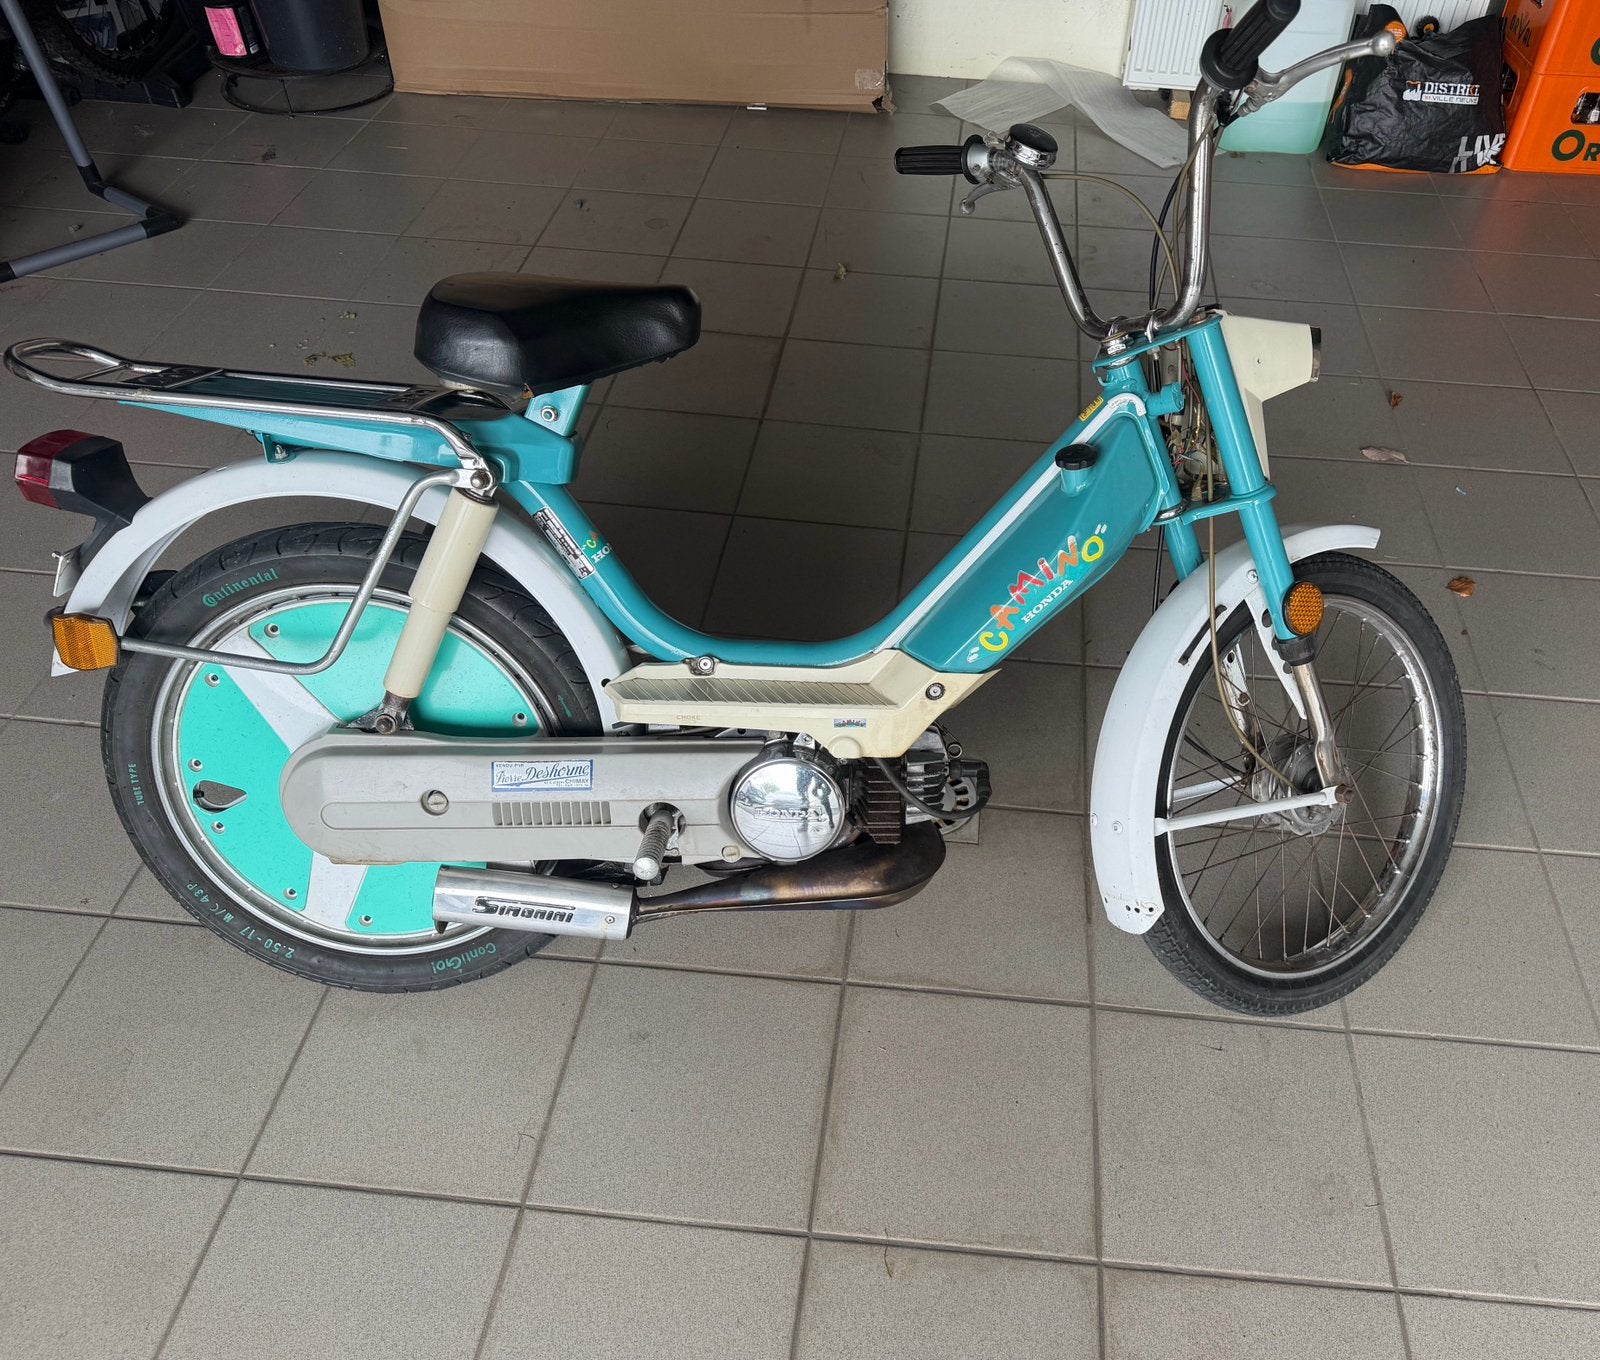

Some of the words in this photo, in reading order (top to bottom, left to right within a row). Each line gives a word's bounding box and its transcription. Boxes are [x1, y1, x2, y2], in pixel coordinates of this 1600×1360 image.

[202, 567, 280, 608] Continental
[1021, 579, 1074, 624] HONDA
[127, 762, 137, 785] TYPE
[525, 763, 590, 781] Deshorme
[130, 784, 145, 806] TUBE
[210, 902, 236, 924] M/C
[239, 925, 294, 959] 2.50-17
